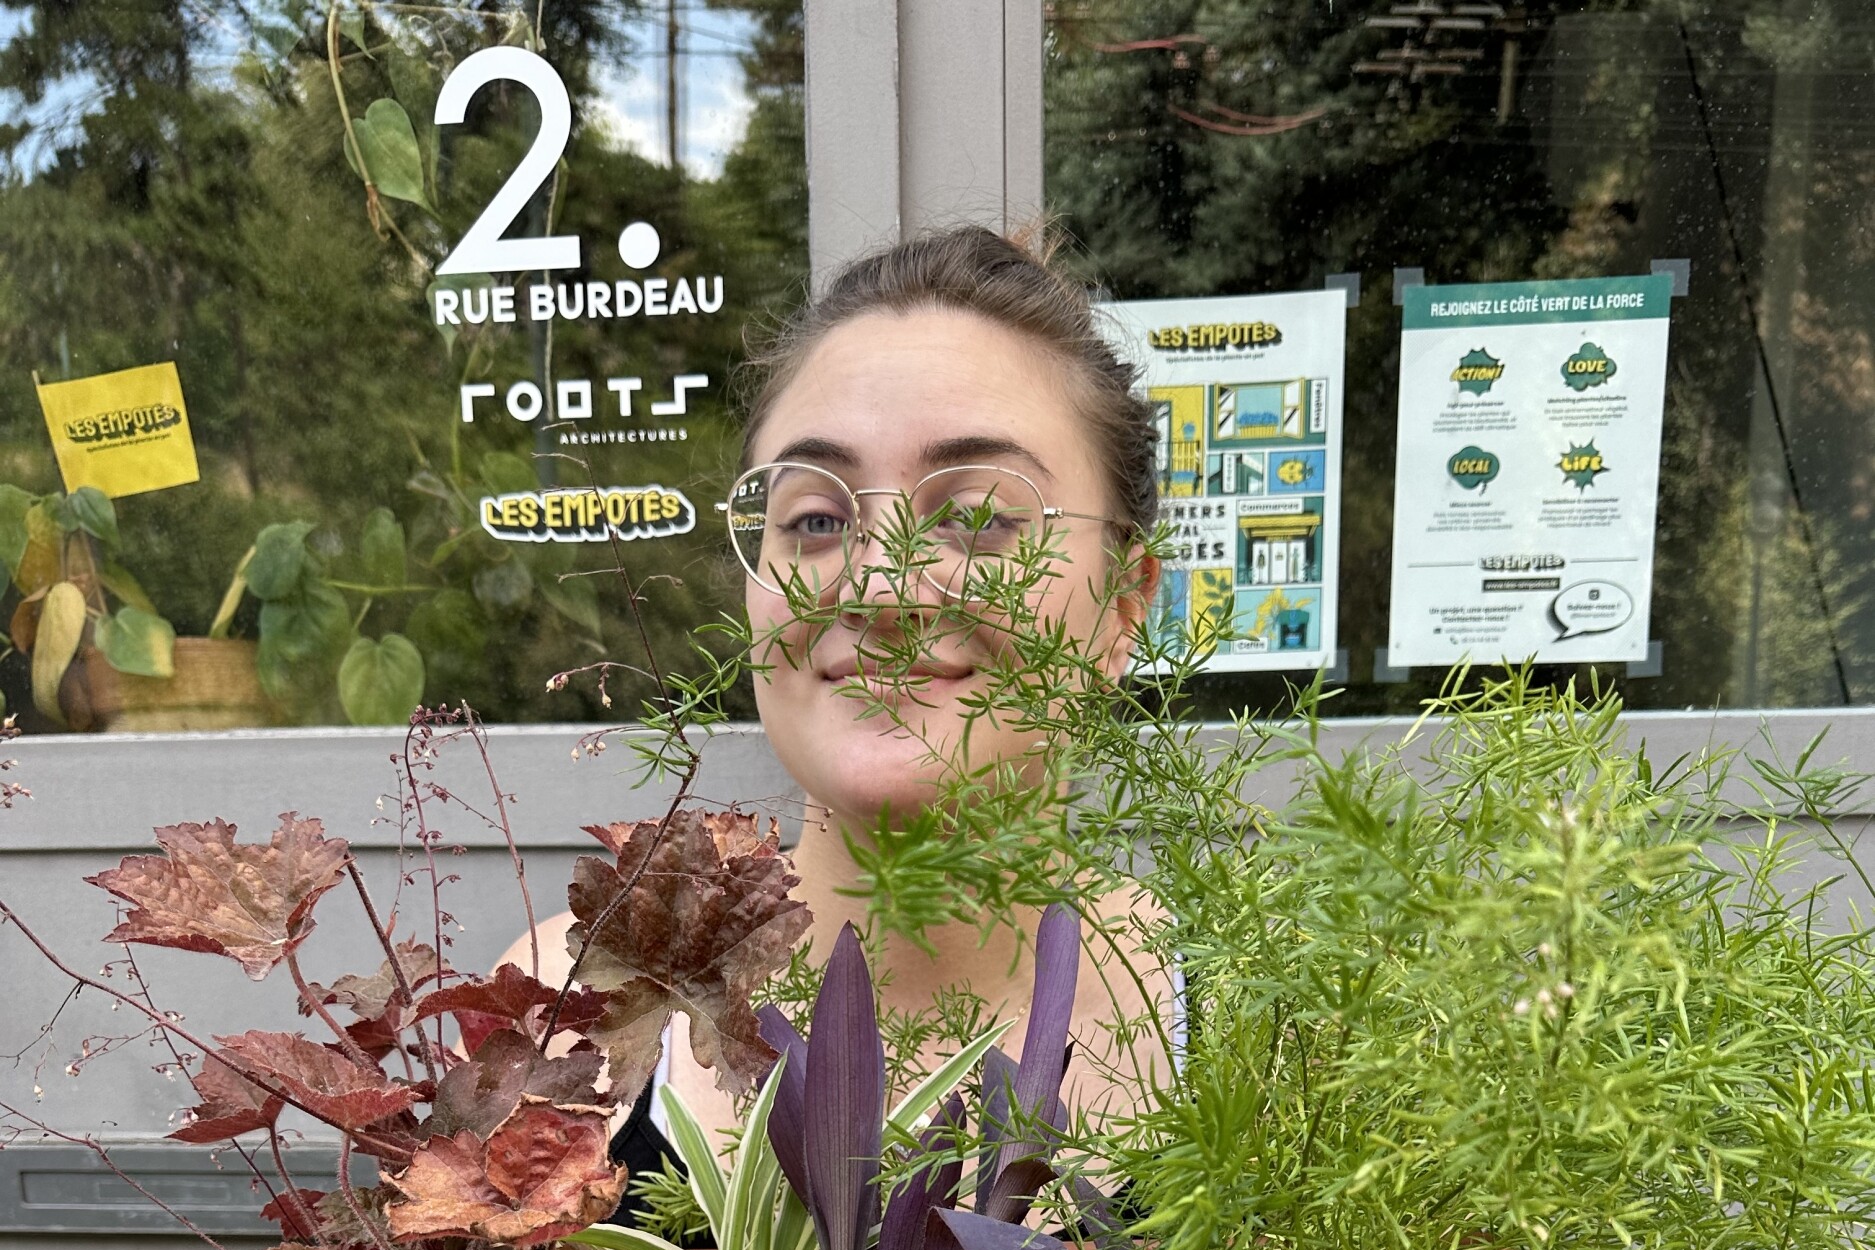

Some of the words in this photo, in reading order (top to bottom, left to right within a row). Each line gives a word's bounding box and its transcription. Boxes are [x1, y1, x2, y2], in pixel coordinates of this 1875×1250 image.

[434, 286, 517, 325] RUE
[529, 275, 725, 321] BURDEAU
[1430, 300, 1492, 317] REJOIGNEZ
[1493, 299, 1508, 314] LE
[1509, 293, 1539, 313] CÔTÉ
[1541, 296, 1570, 312] VERT
[1571, 295, 1588, 311] DE
[1589, 294, 1604, 310] LA
[1606, 292, 1645, 309] FORCE
[1148, 327, 1185, 351] LES
[1186, 320, 1282, 351] EMPOTÉS
[1451, 364, 1506, 383] ACTION!
[1567, 359, 1608, 374] LOVE
[64, 416, 100, 442] LES
[97, 403, 181, 439] EMPOTÉS
[559, 428, 689, 446] ARCHITECTURES
[1453, 459, 1492, 475] LOCAL
[485, 497, 546, 530] LES
[544, 489, 690, 530] EMPOTÉS
